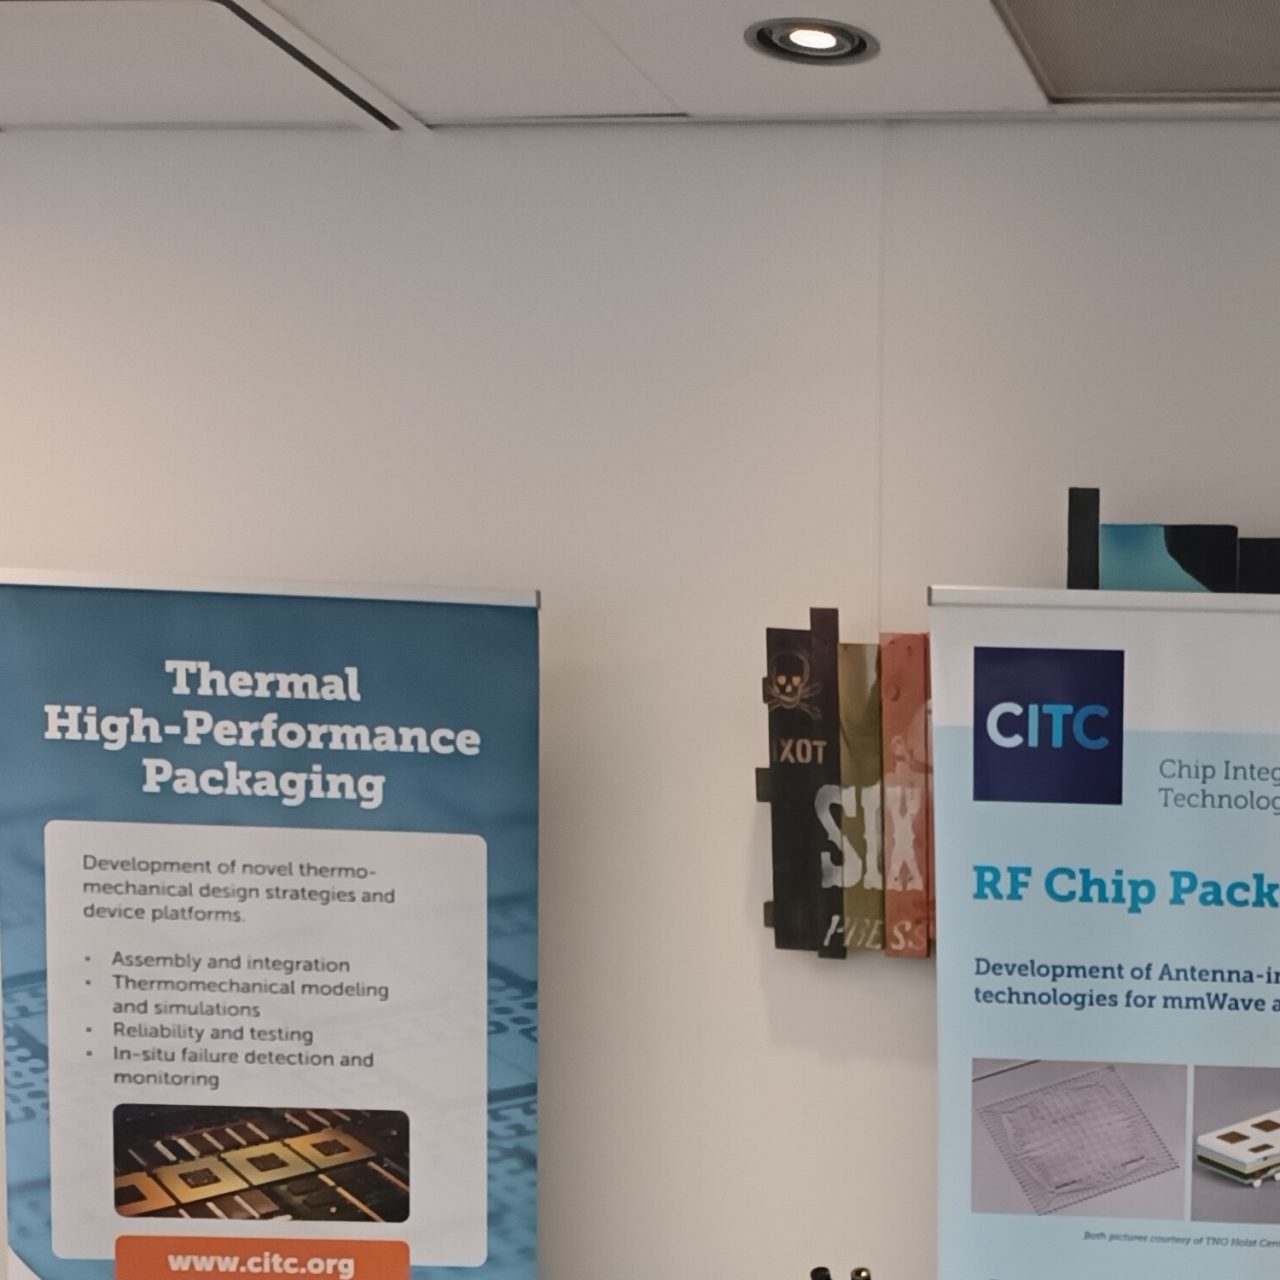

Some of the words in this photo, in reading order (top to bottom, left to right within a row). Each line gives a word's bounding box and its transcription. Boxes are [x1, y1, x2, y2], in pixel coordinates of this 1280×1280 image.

[165, 660, 360, 701] Thermal
[44, 705, 480, 756] High-Performance
[986, 702, 1109, 750] CITC
[780, 739, 827, 764] XOT
[143, 758, 385, 809] Packaging
[1159, 759, 1216, 784] Chip
[815, 784, 923, 891] SIX
[83, 855, 211, 876] Development
[217, 859, 236, 875] of
[242, 861, 293, 877] novel
[299, 862, 376, 878] thermo-
[83, 880, 193, 897] mechanical
[199, 883, 259, 902] design
[266, 885, 356, 904] strategies
[361, 888, 394, 903] and
[972, 865, 1031, 901] RF
[1044, 867, 1156, 914] Chip
[83, 903, 145, 920] device
[151, 905, 245, 924] platforms.
[112, 952, 201, 972] Assembly
[208, 954, 241, 970] and
[247, 956, 350, 976] integration
[974, 958, 1123, 982] Development
[1130, 963, 1152, 981] of
[113, 976, 295, 995] Thermomechanical
[301, 980, 389, 1000] modeling
[974, 987, 1118, 1011] technologies
[1124, 990, 1156, 1009] for
[1162, 993, 1265, 1013] mmWave
[113, 1000, 148, 1015] and
[154, 1001, 260, 1017] simulations
[113, 1023, 204, 1043] Reliability
[210, 1025, 244, 1040] and
[250, 1027, 313, 1044] testing
[113, 1047, 175, 1062] In-situ
[181, 1048, 238, 1064] failure
[245, 1050, 334, 1067] detection
[340, 1052, 373, 1068] and
[113, 1071, 219, 1090] monitoring
[1084, 1232, 1106, 1240] Both
[1109, 1232, 1147, 1242] pictures
[1151, 1235, 1191, 1246] courtesy
[1206, 1237, 1228, 1246] TNO
[1232, 1238, 1257, 1247] Holst
[168, 1252, 355, 1280] www.citc.org
